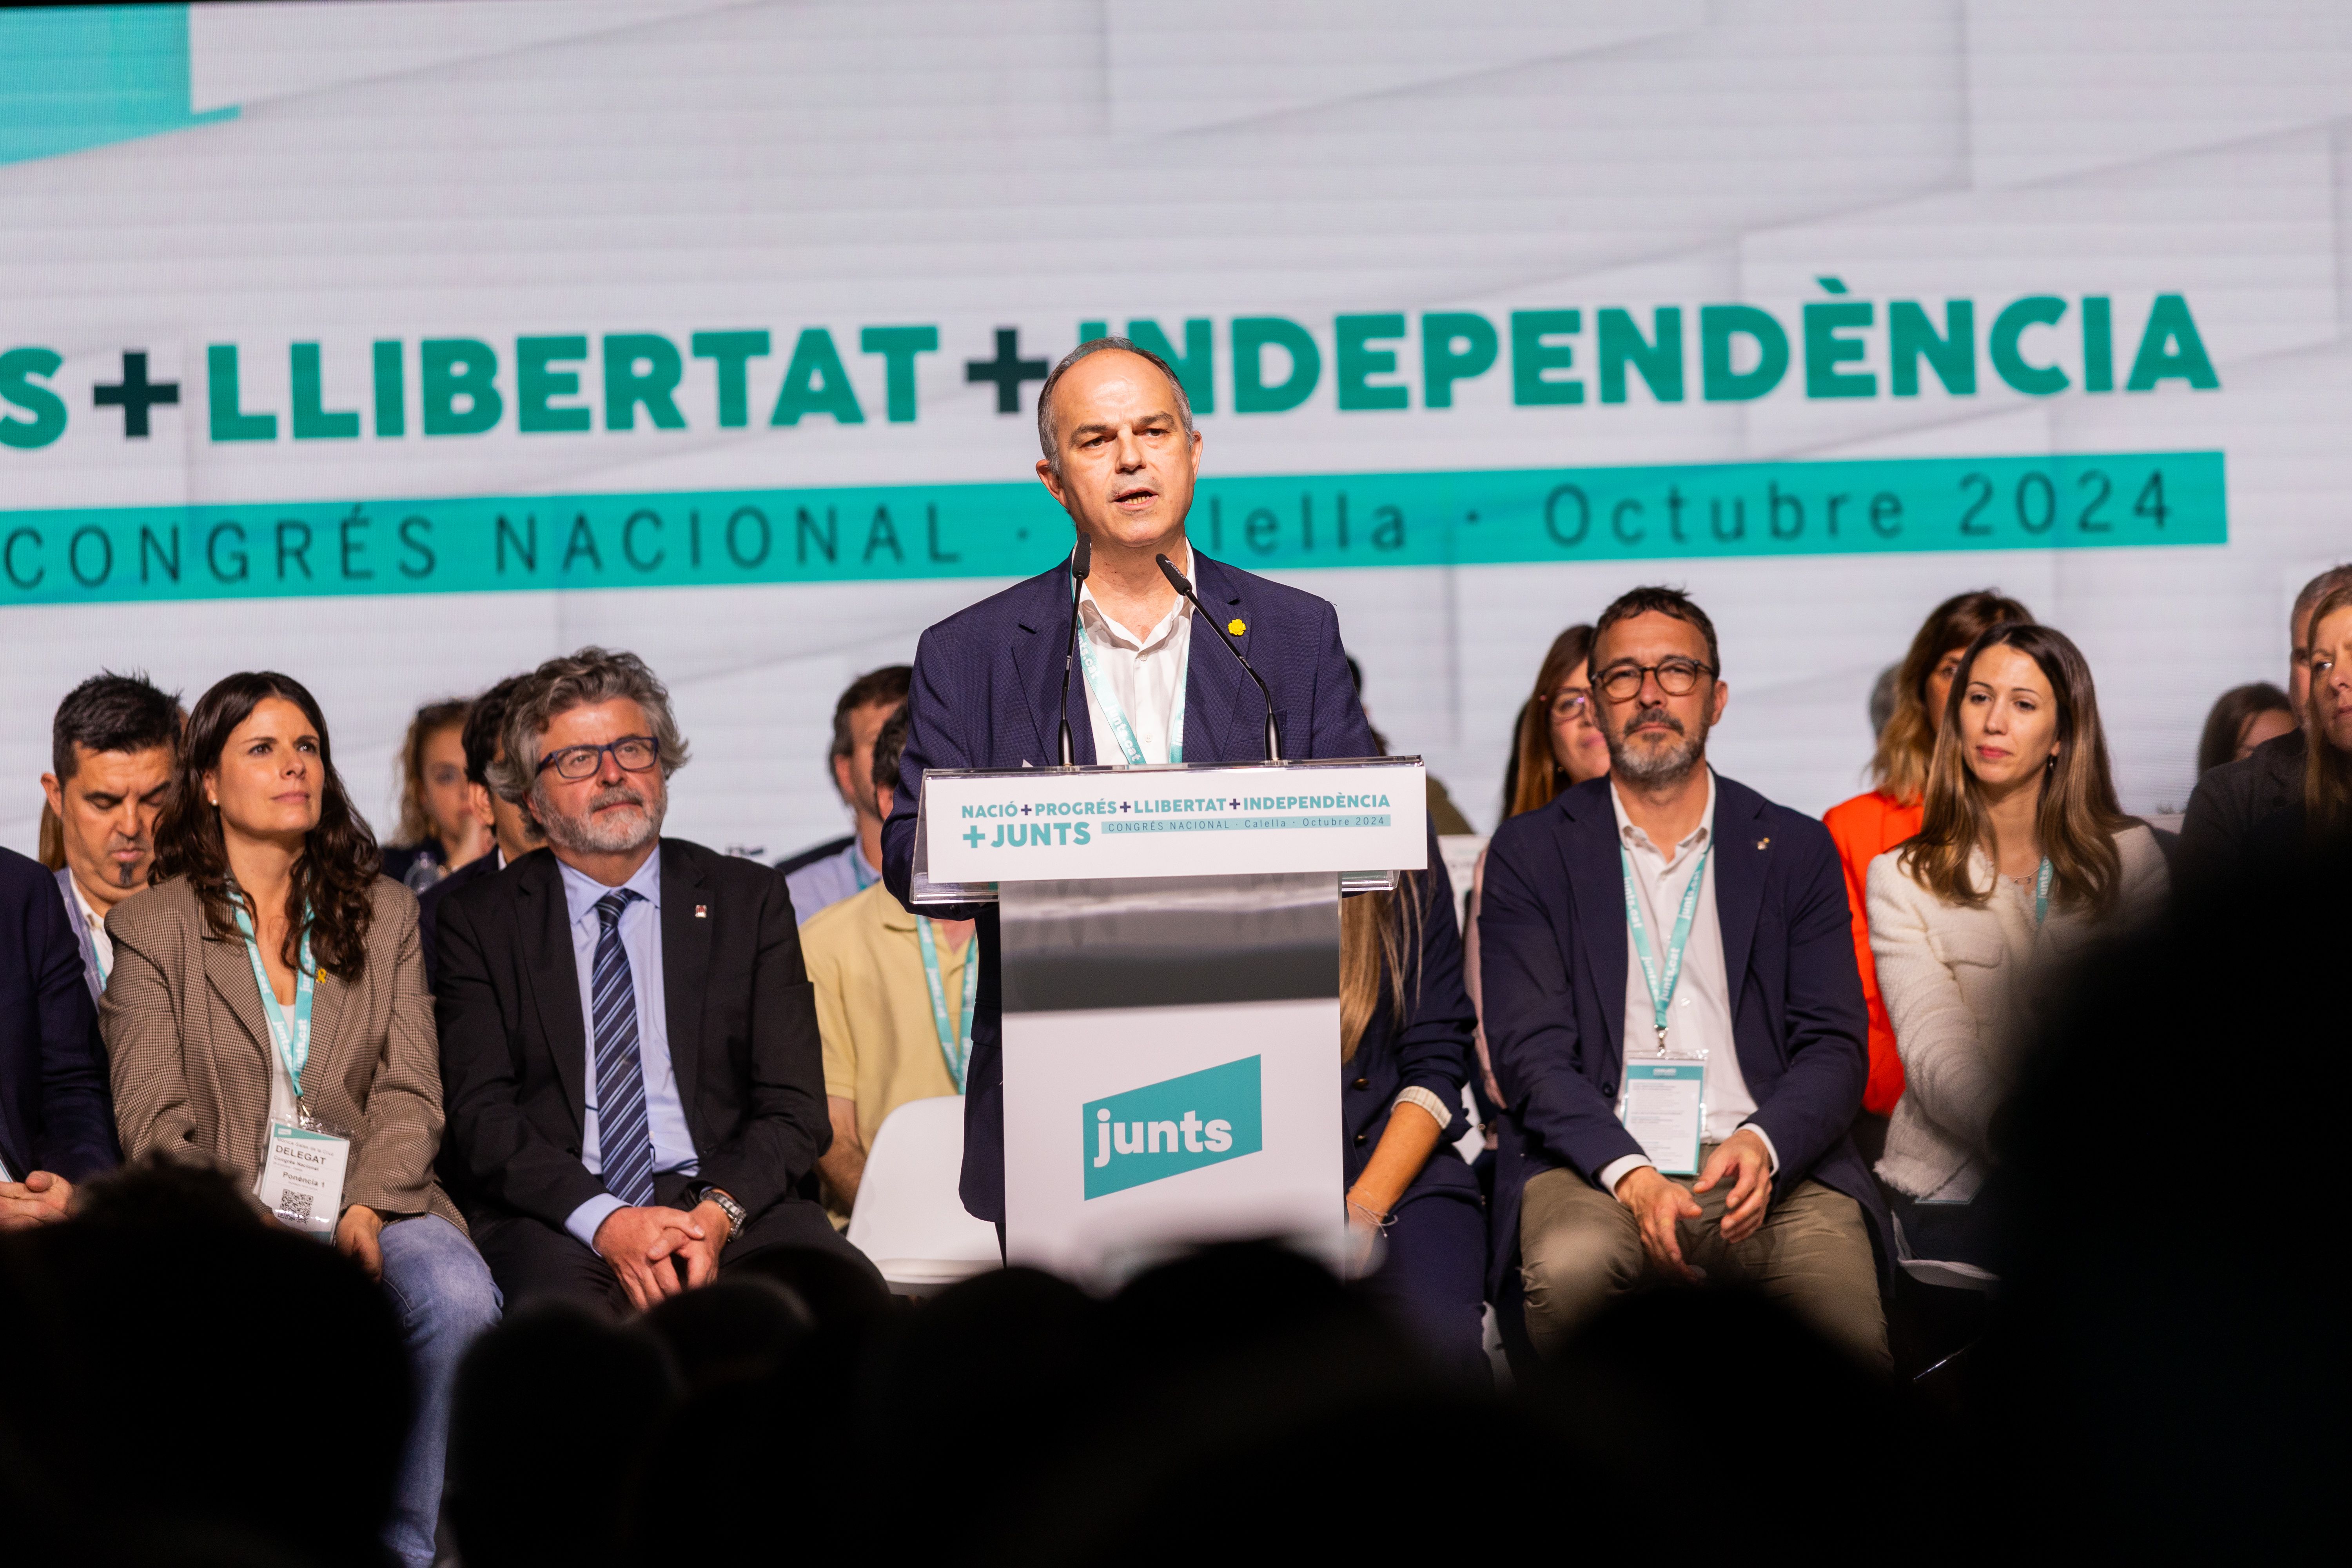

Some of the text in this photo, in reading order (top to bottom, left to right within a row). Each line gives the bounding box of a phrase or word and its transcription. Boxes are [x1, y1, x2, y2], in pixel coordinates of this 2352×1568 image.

[207, 326, 938, 442] LLIBERTAT
[1079, 276, 2220, 414] NDEPENDÈNCIA
[3, 468, 2171, 589] CONGRÉS NACIONAL lella Octubre 2024
[1108, 816, 1384, 832] CONGRÉS NACIONAL Calella Octubre 2024
[276, 1145, 326, 1165] DELEGAT
[1094, 1108, 1233, 1168] junts
[283, 1171, 318, 1186] Ponència
